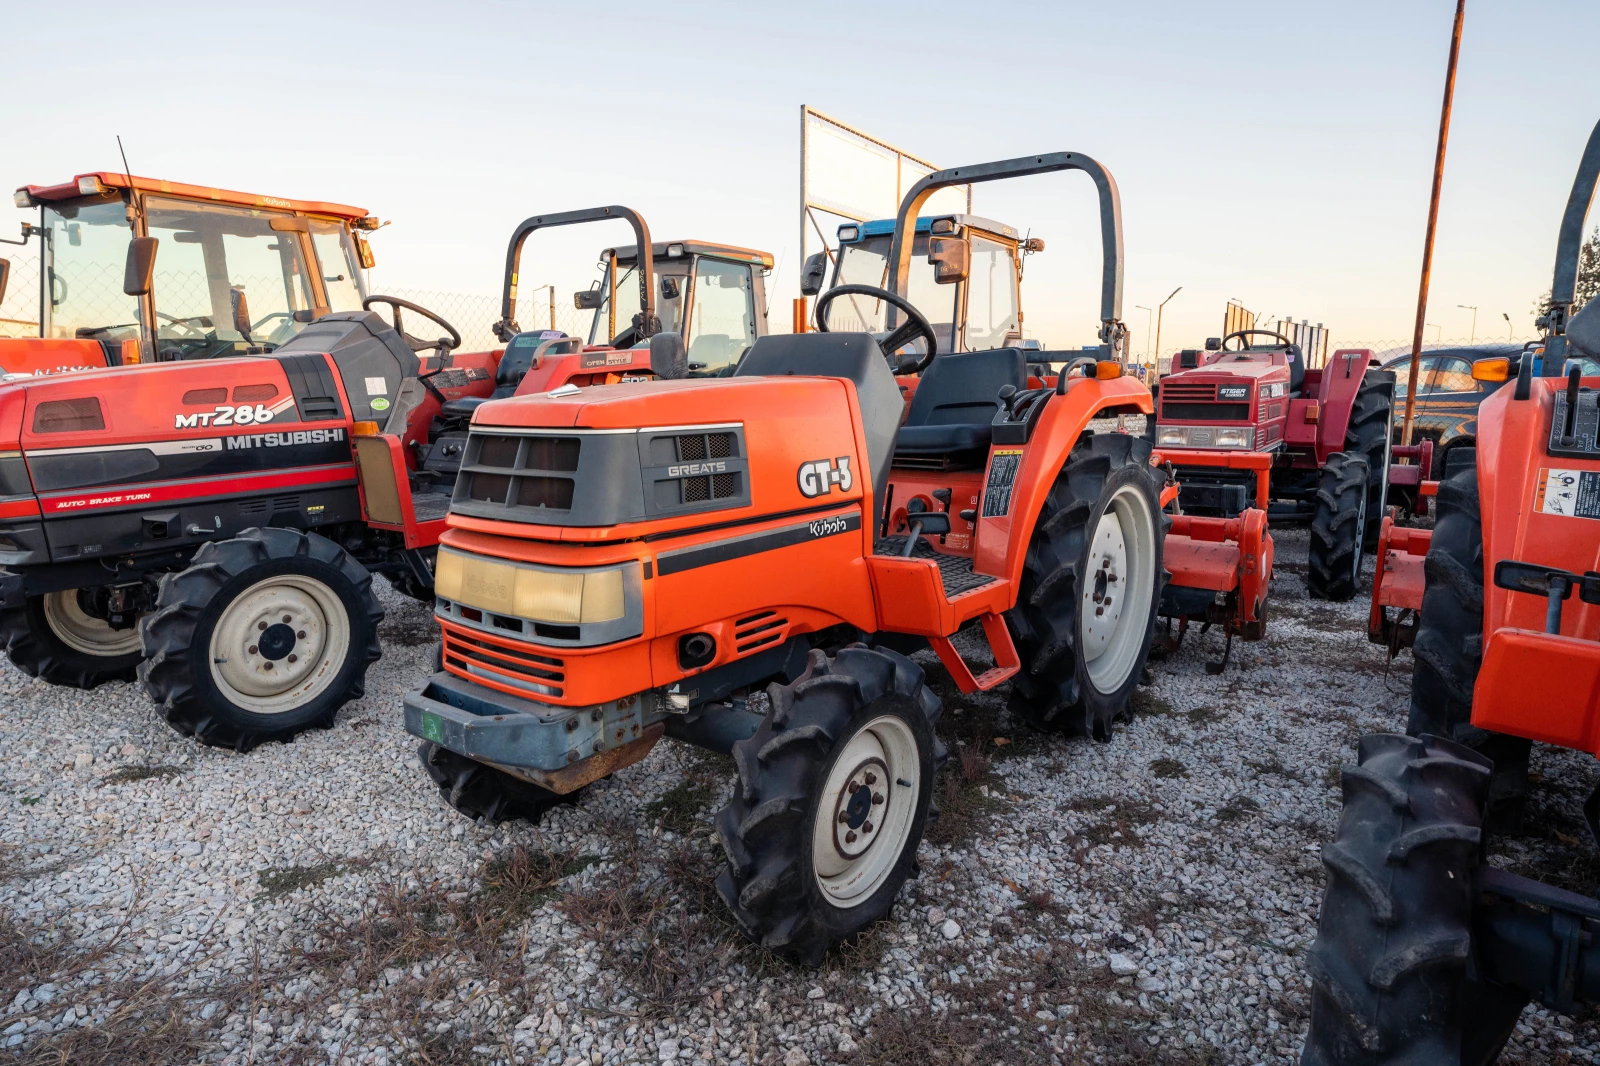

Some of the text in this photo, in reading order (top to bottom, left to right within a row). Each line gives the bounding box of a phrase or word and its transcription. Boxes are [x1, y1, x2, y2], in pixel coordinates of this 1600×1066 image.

[263, 197, 291, 208] Kubota
[175, 404, 275, 429] MT286
[226, 428, 344, 450] MITSUBISHI
[668, 461, 726, 477] GREATS
[797, 455, 852, 499] GT-3
[56, 493, 151, 509] AUTO BRAKE TURN
[809, 517, 847, 537] Kubota
